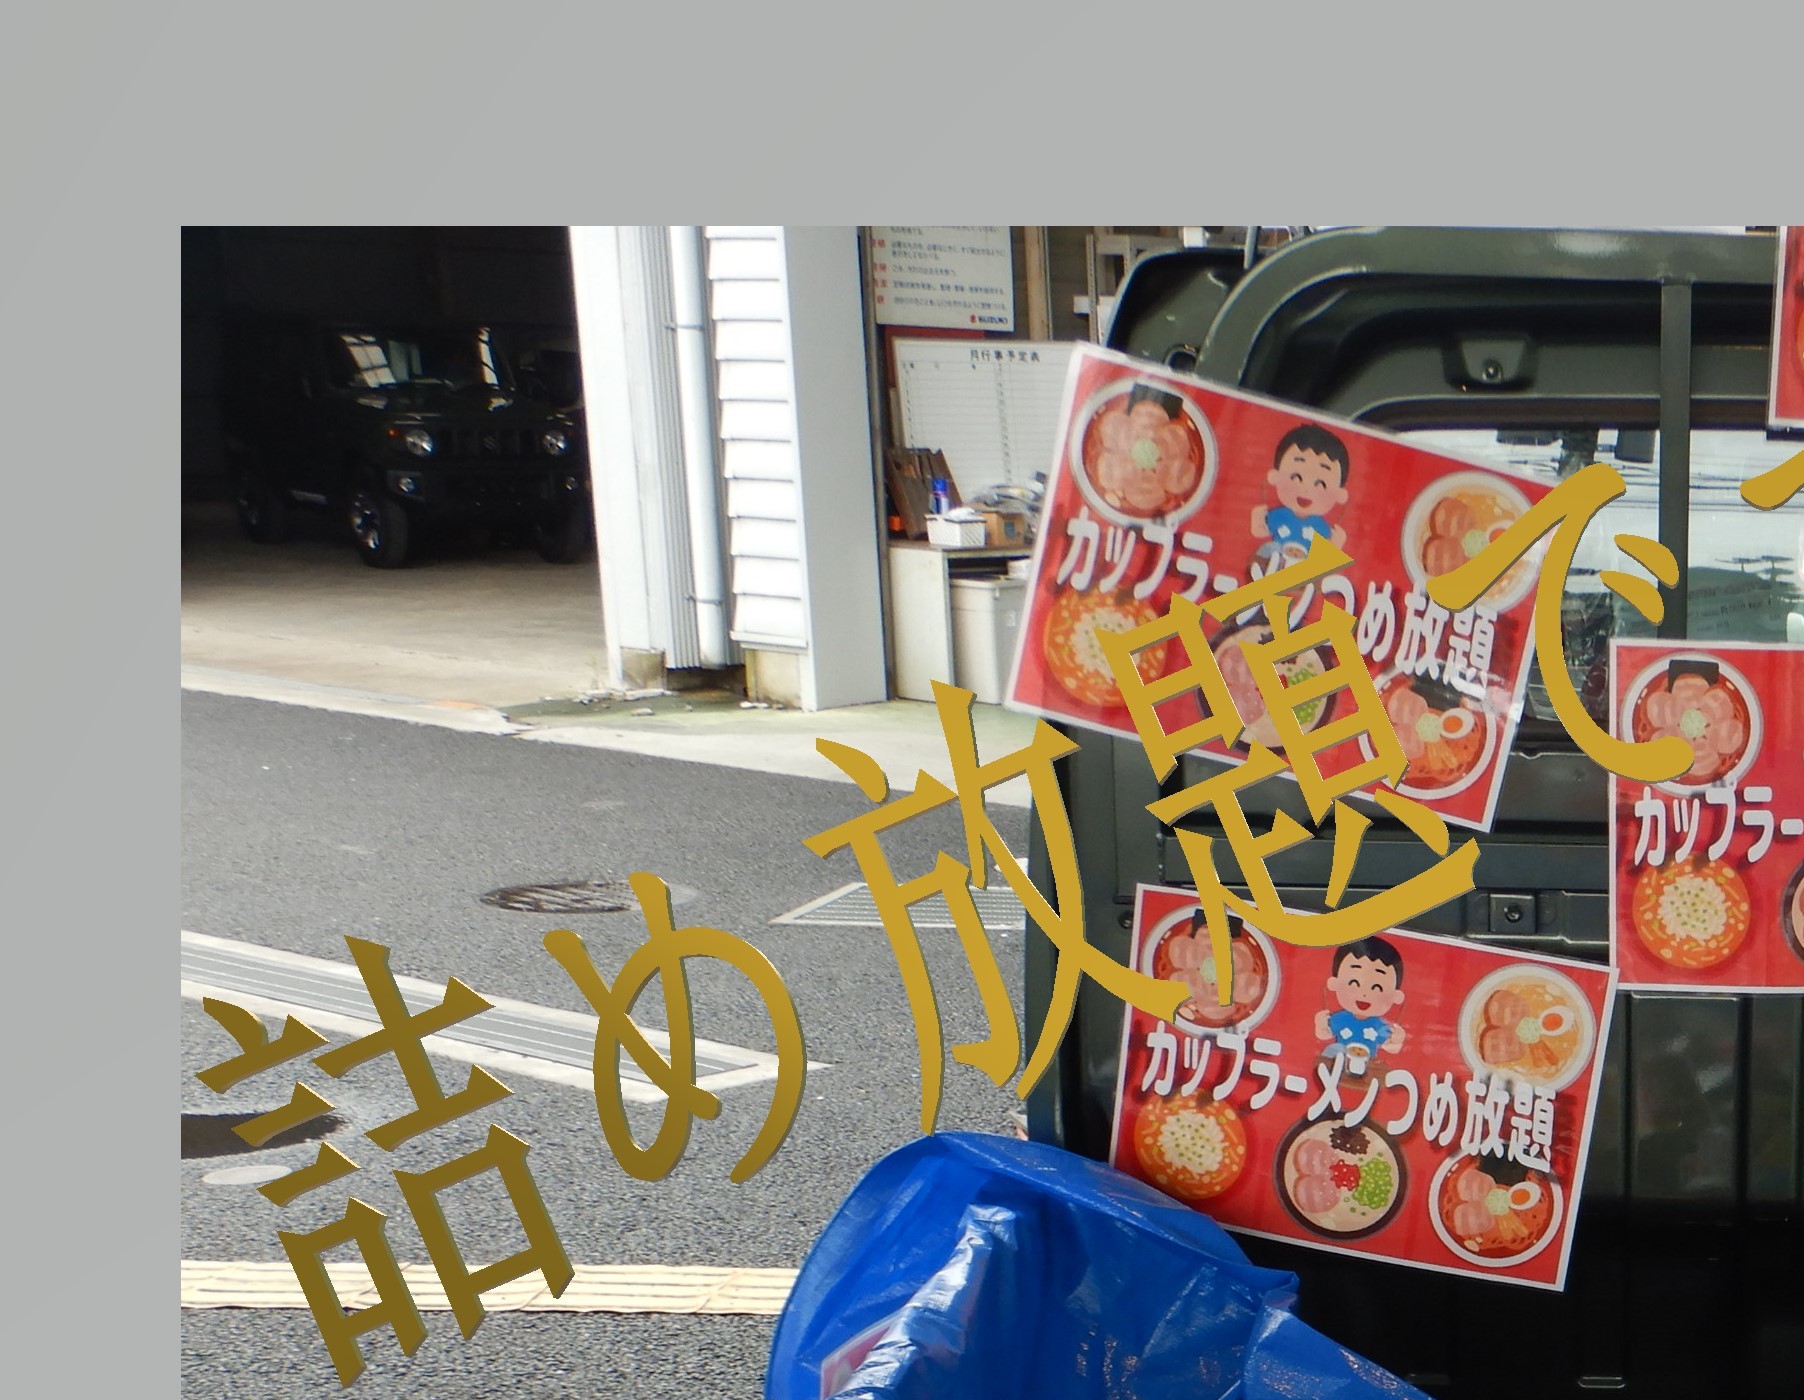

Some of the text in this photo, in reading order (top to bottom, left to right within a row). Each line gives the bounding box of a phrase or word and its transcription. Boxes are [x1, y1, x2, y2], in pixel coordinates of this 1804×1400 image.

[1141, 1020, 1556, 1173] カップラーメンつめ放題
